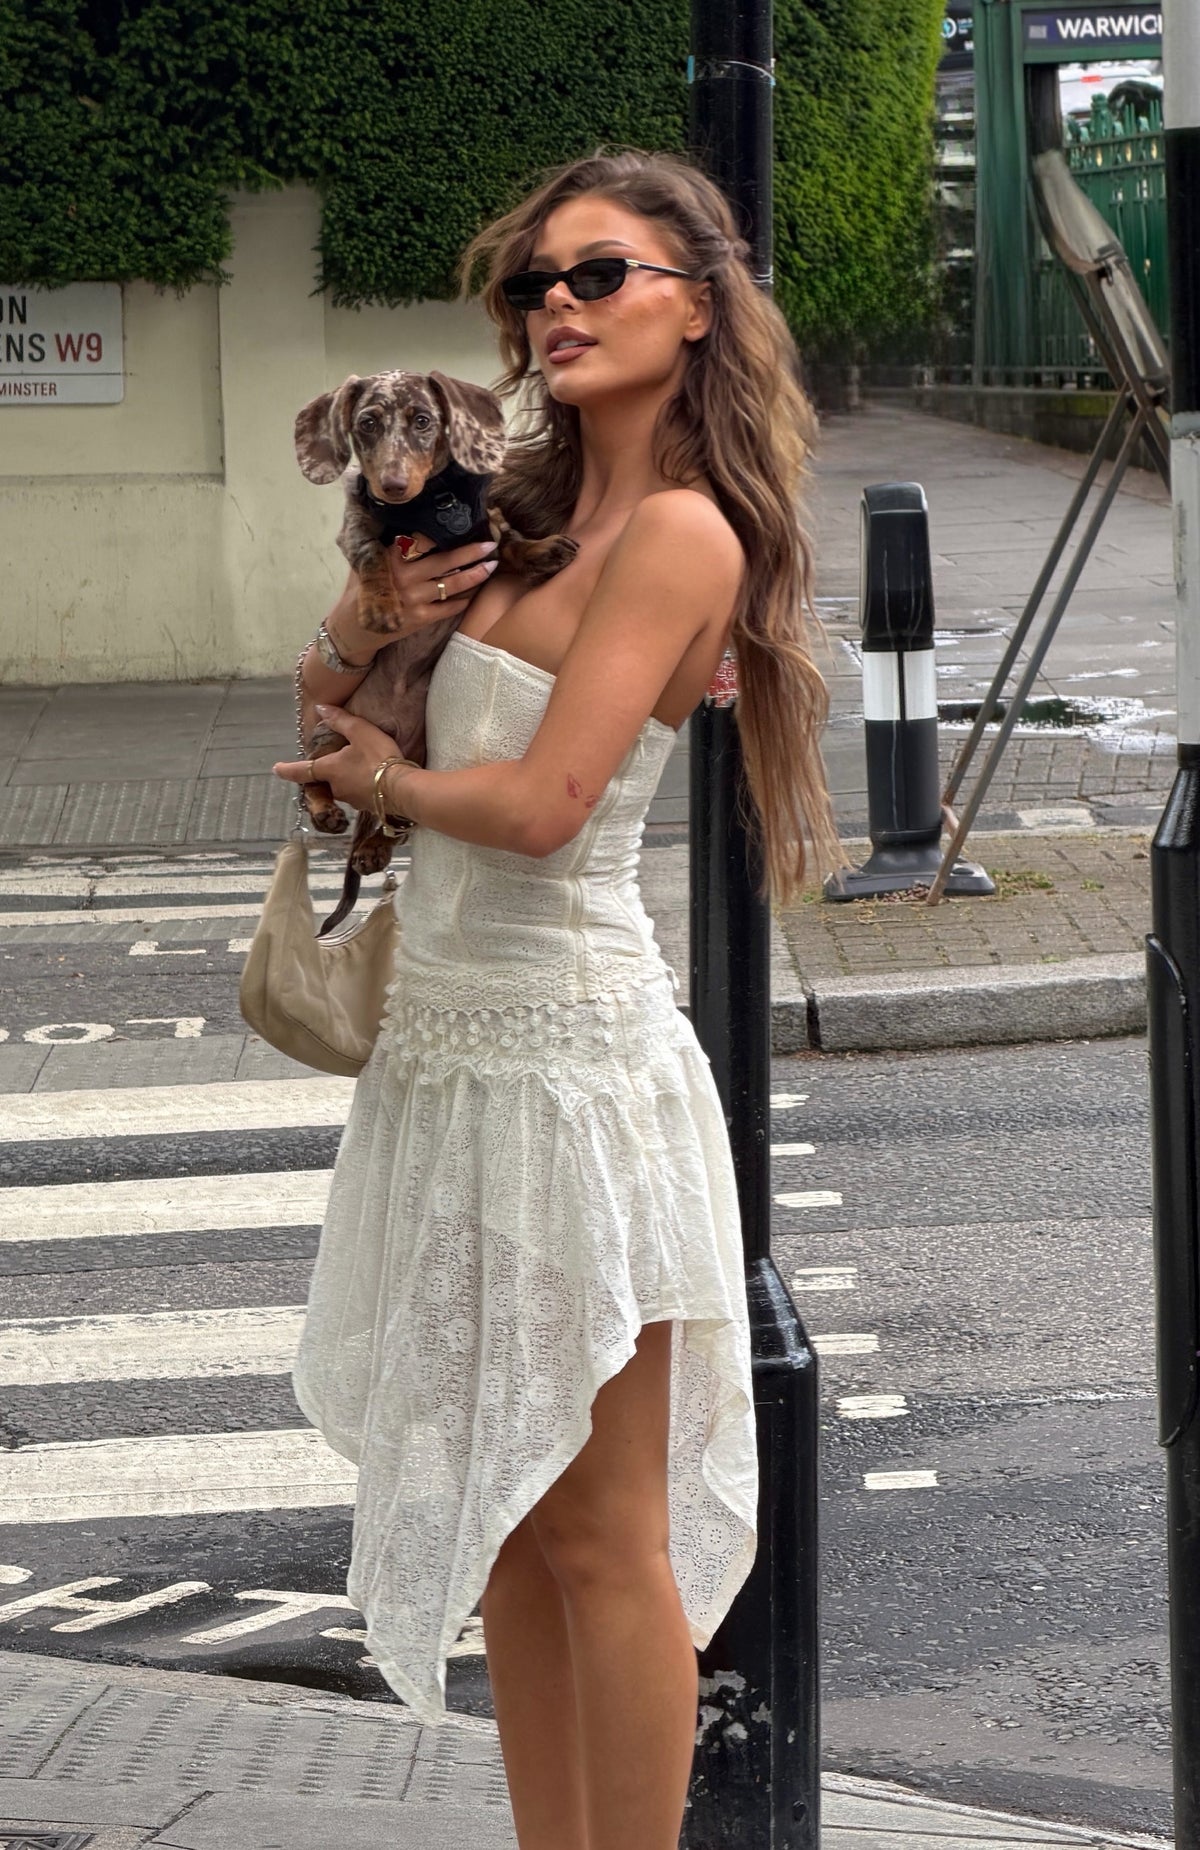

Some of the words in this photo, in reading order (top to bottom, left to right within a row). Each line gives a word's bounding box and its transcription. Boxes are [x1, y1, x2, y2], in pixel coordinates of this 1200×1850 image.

[1056, 14, 1163, 39] WARWIC
[0, 295, 27, 325] N
[0, 333, 46, 363] NS
[54, 332, 103, 363] W9
